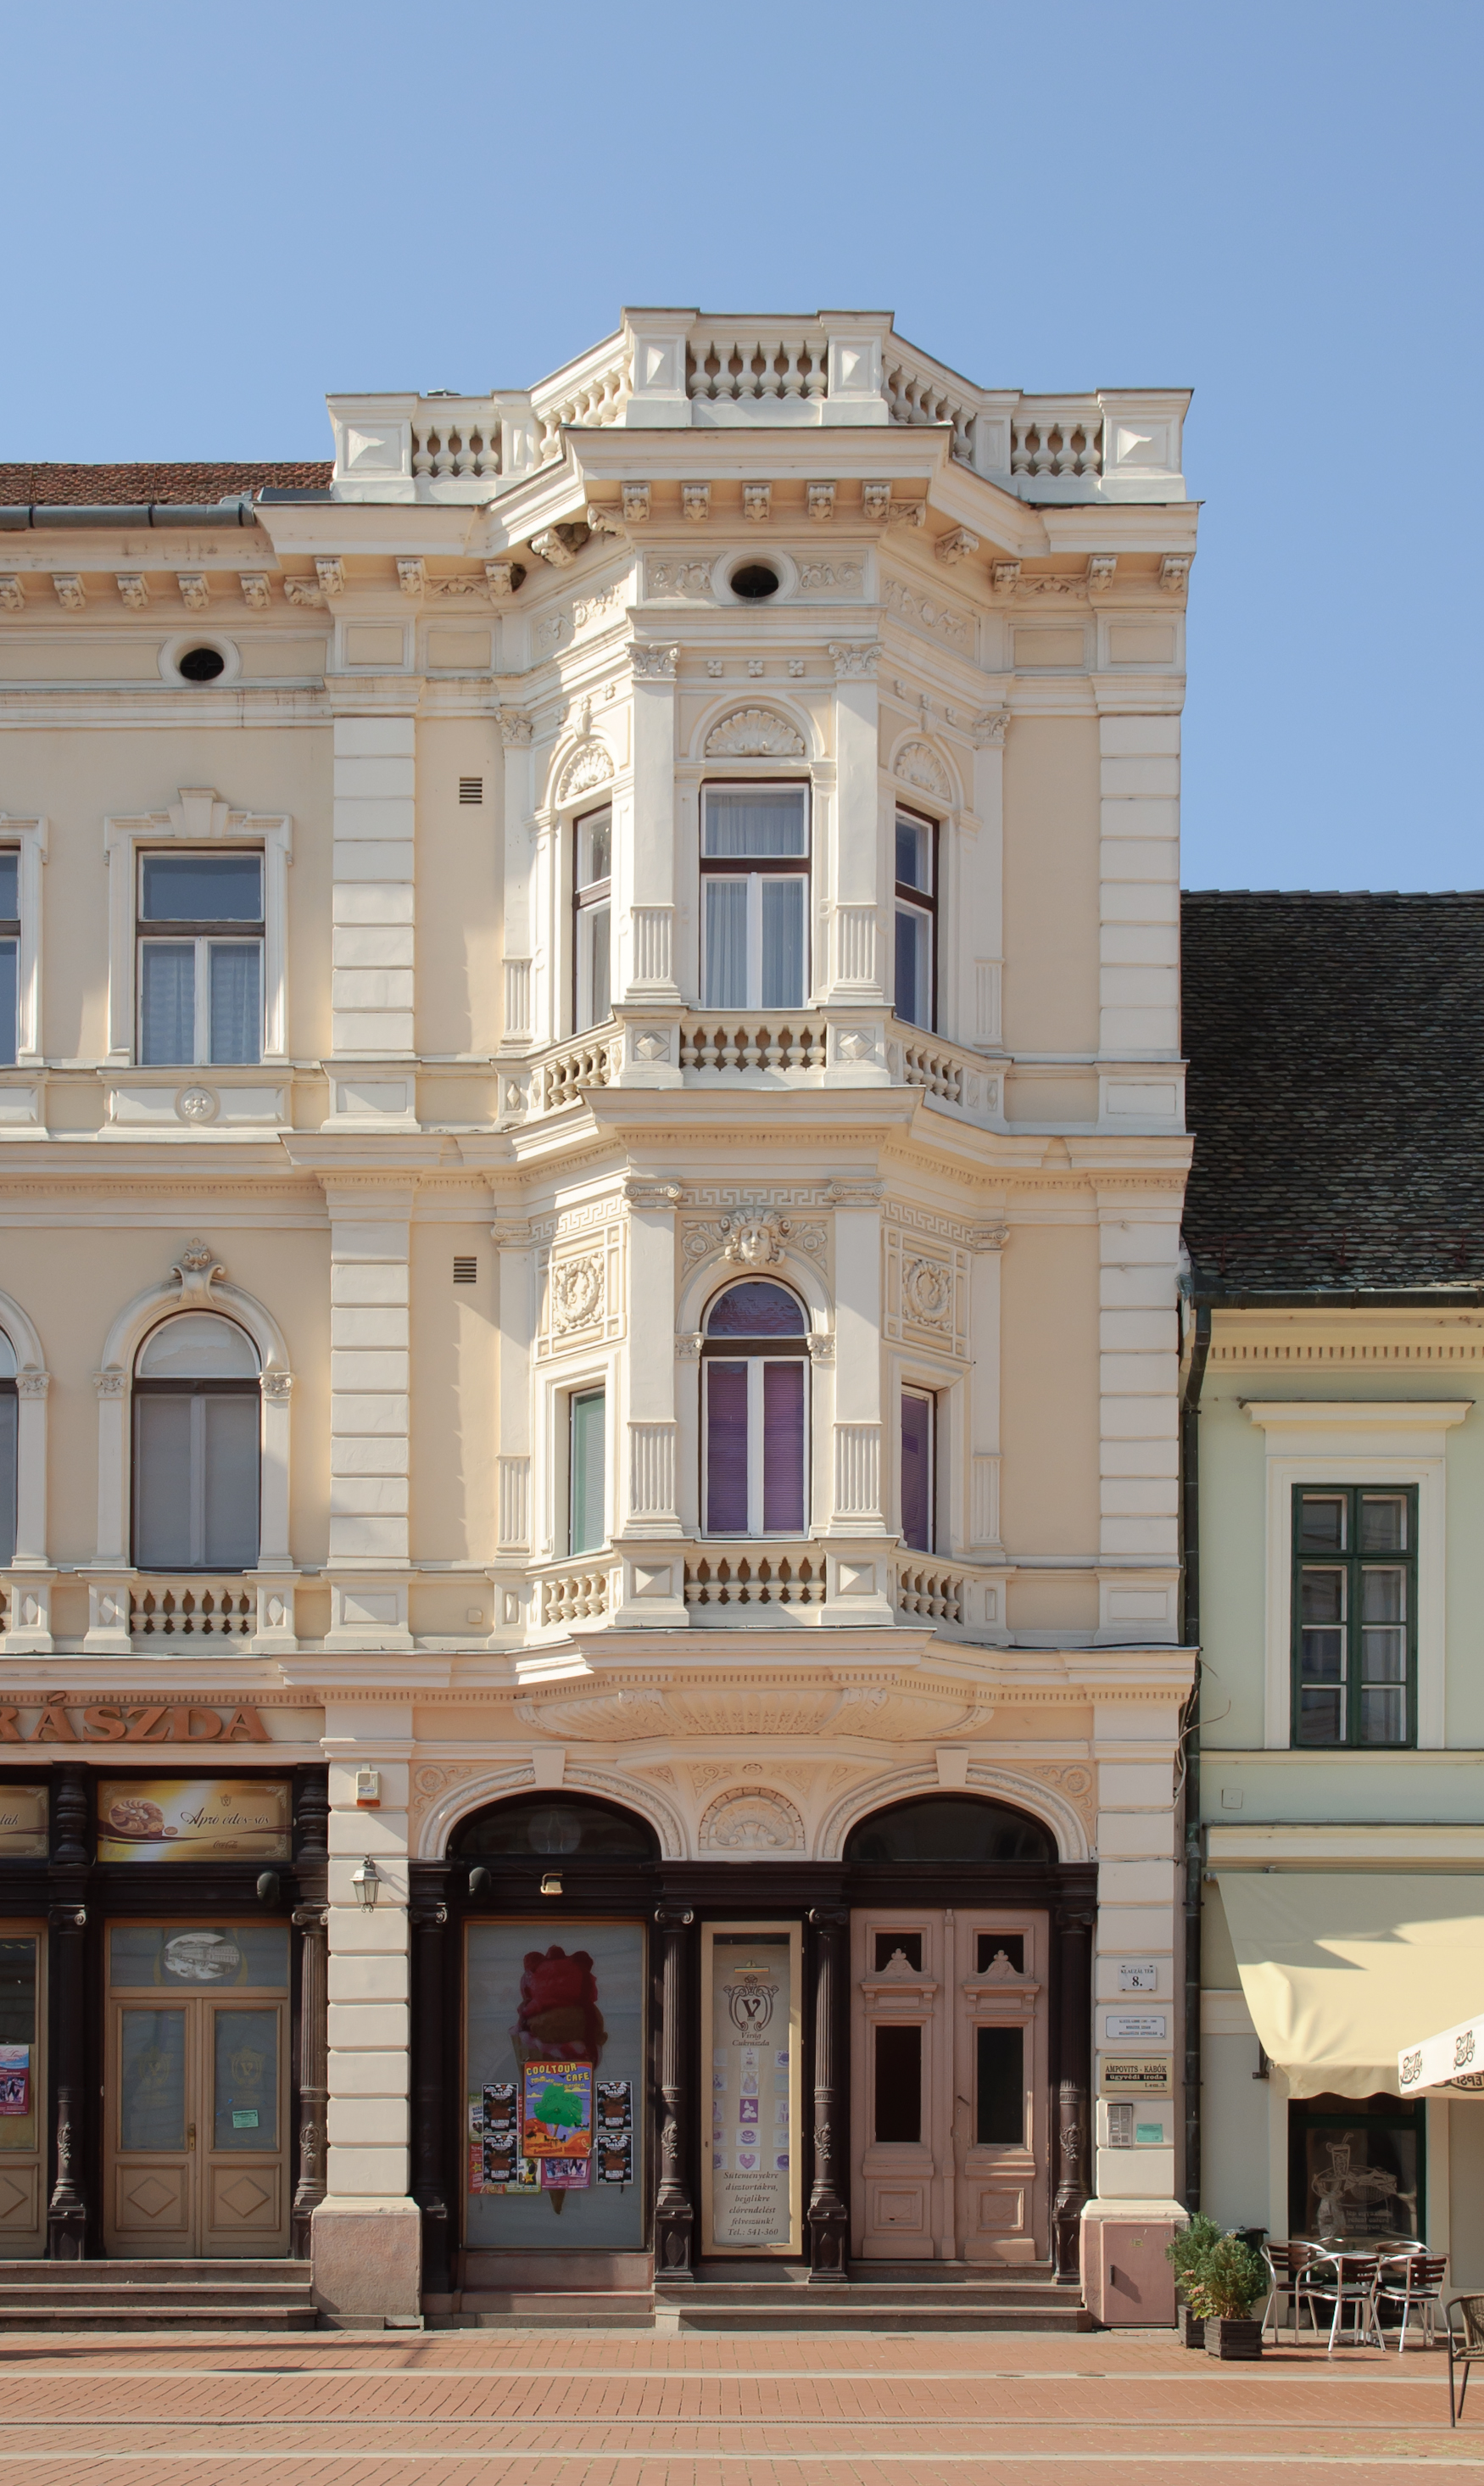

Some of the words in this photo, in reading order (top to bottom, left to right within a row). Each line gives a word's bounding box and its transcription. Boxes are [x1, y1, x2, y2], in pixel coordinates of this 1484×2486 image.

[181, 1807, 220, 1828] Apró
[1132, 1975, 1143, 1986] 8.
[526, 2063, 577, 2075] COOLTOUR
[566, 2072, 590, 2082] CAFE
[723, 2171, 779, 2181] Süteményekre
